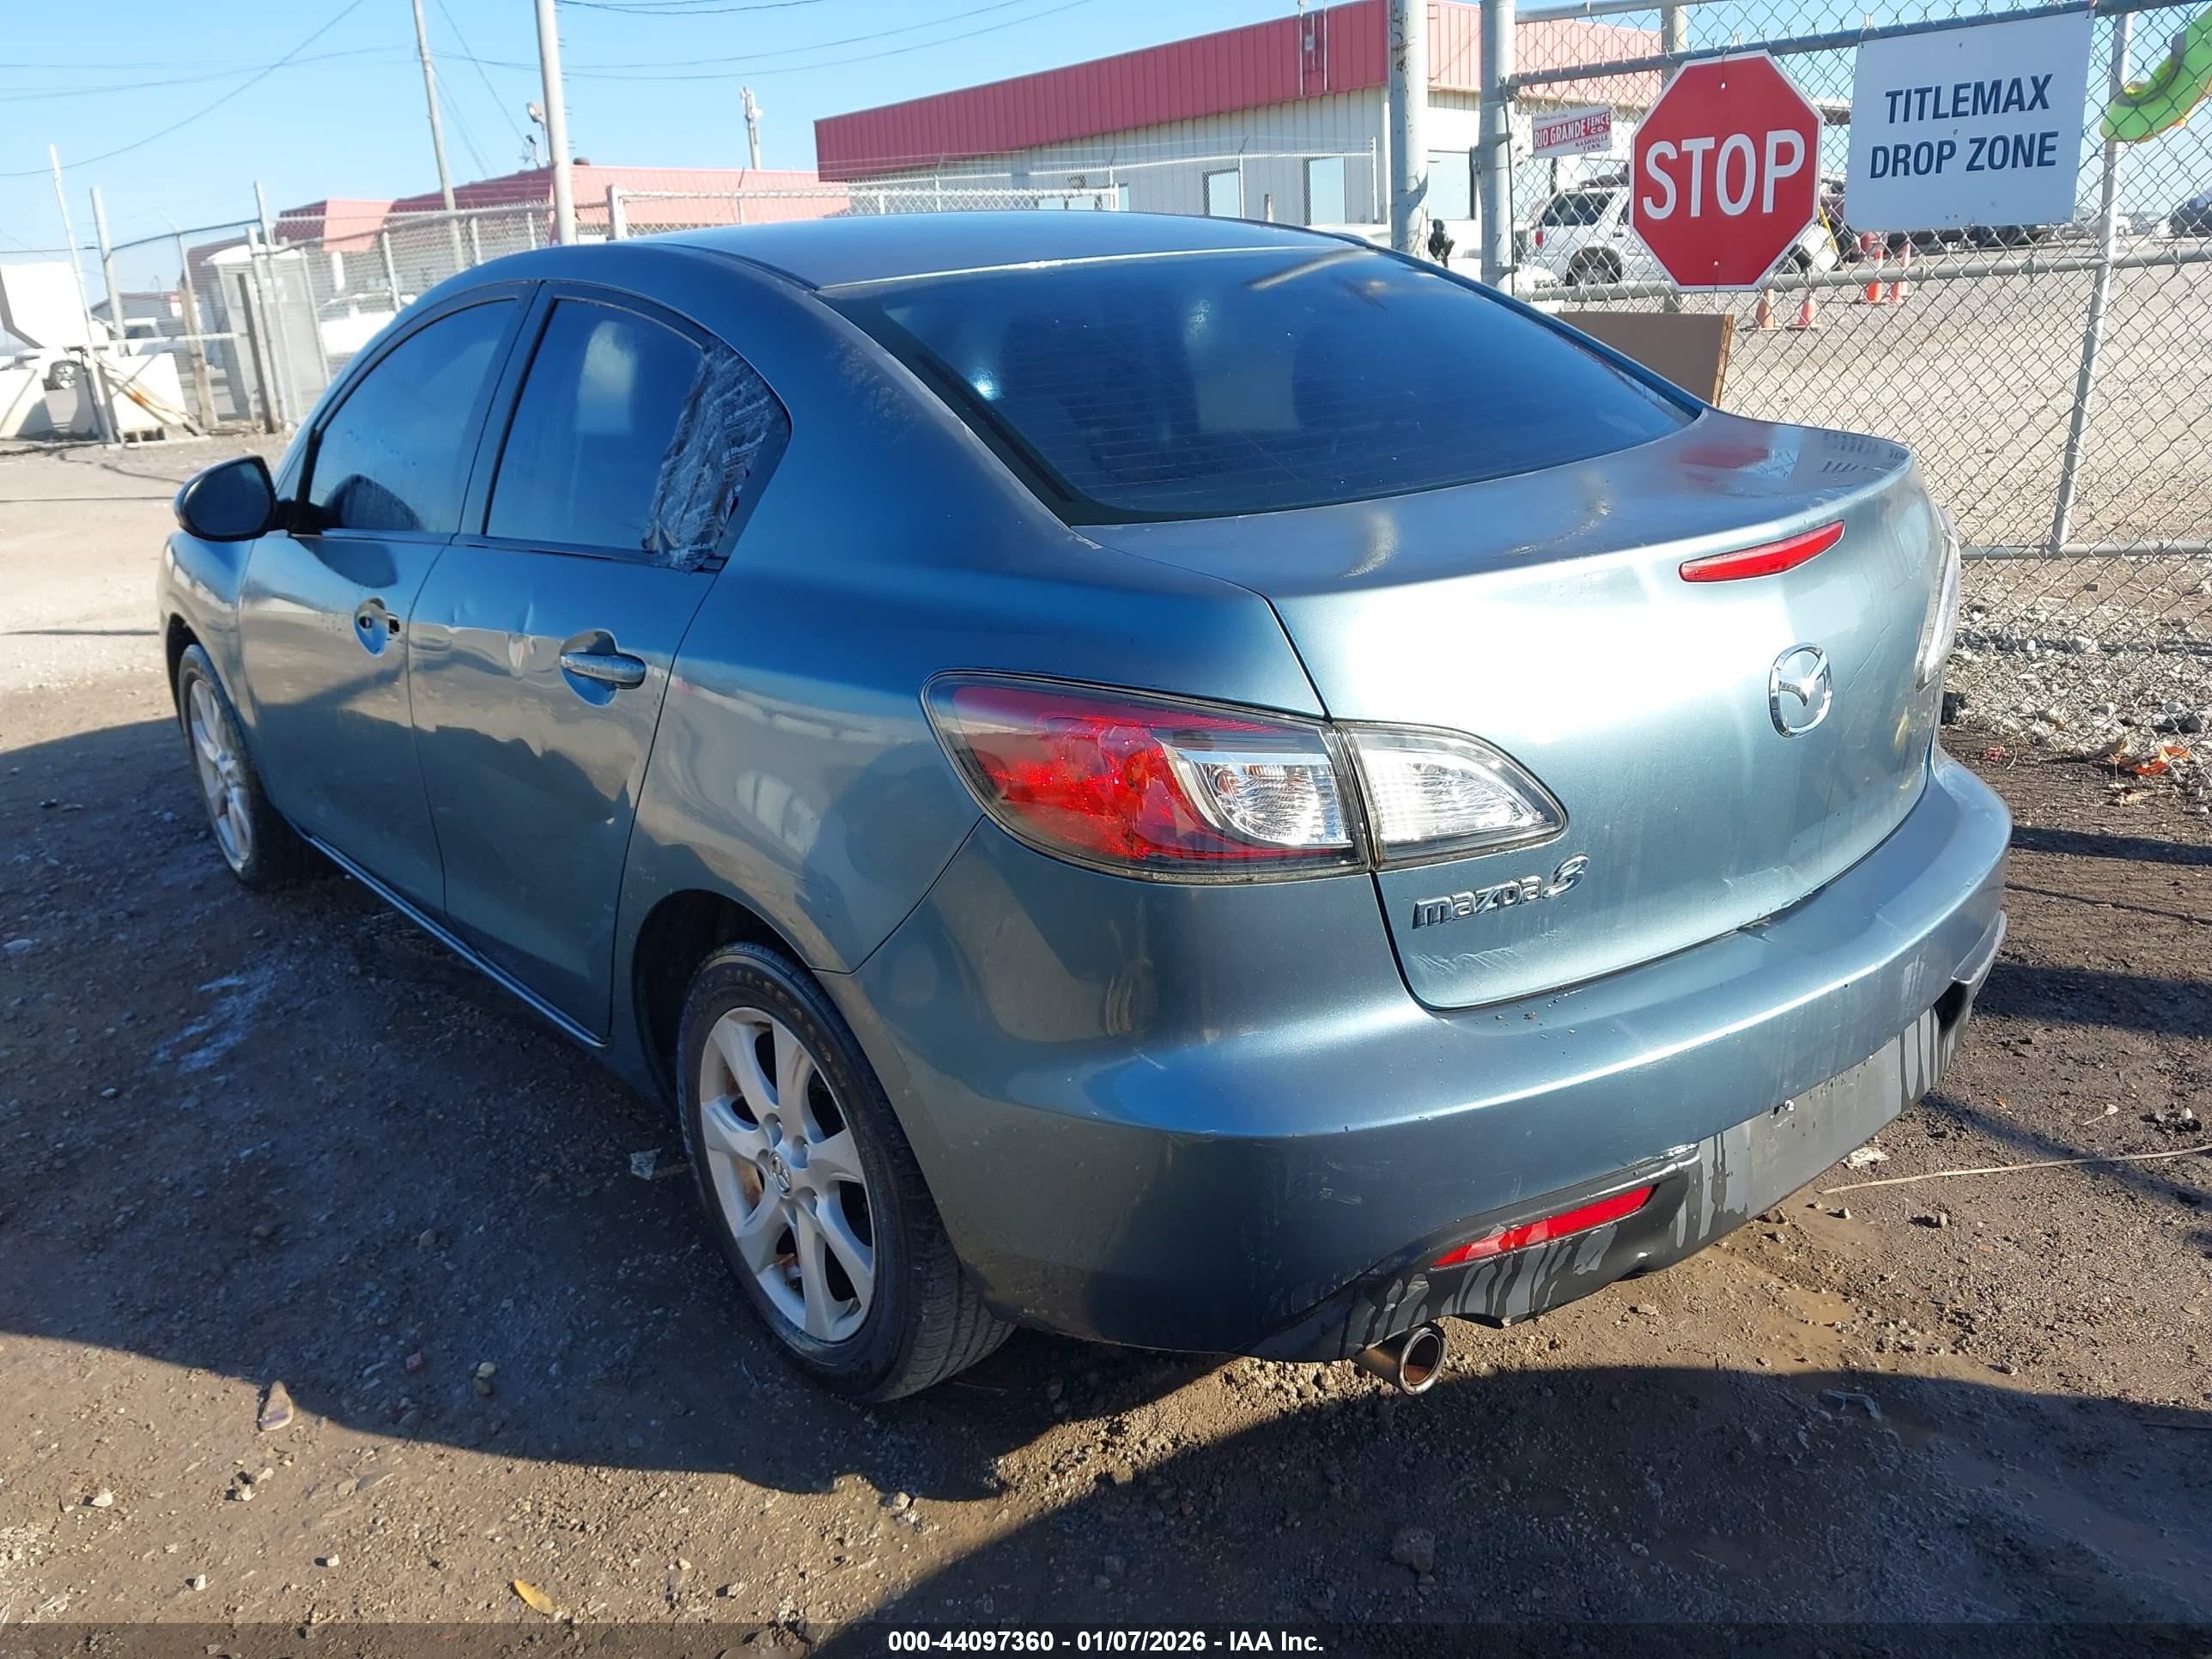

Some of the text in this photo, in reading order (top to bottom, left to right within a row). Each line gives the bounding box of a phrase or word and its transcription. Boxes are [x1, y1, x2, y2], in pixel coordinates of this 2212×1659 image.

[1885, 74, 2053, 124] TITLEMAX
[1534, 112, 1610, 149] RIO GRANDE FENCE
[1870, 131, 2059, 179] DROP ZONE
[1643, 129, 1805, 220] STOP
